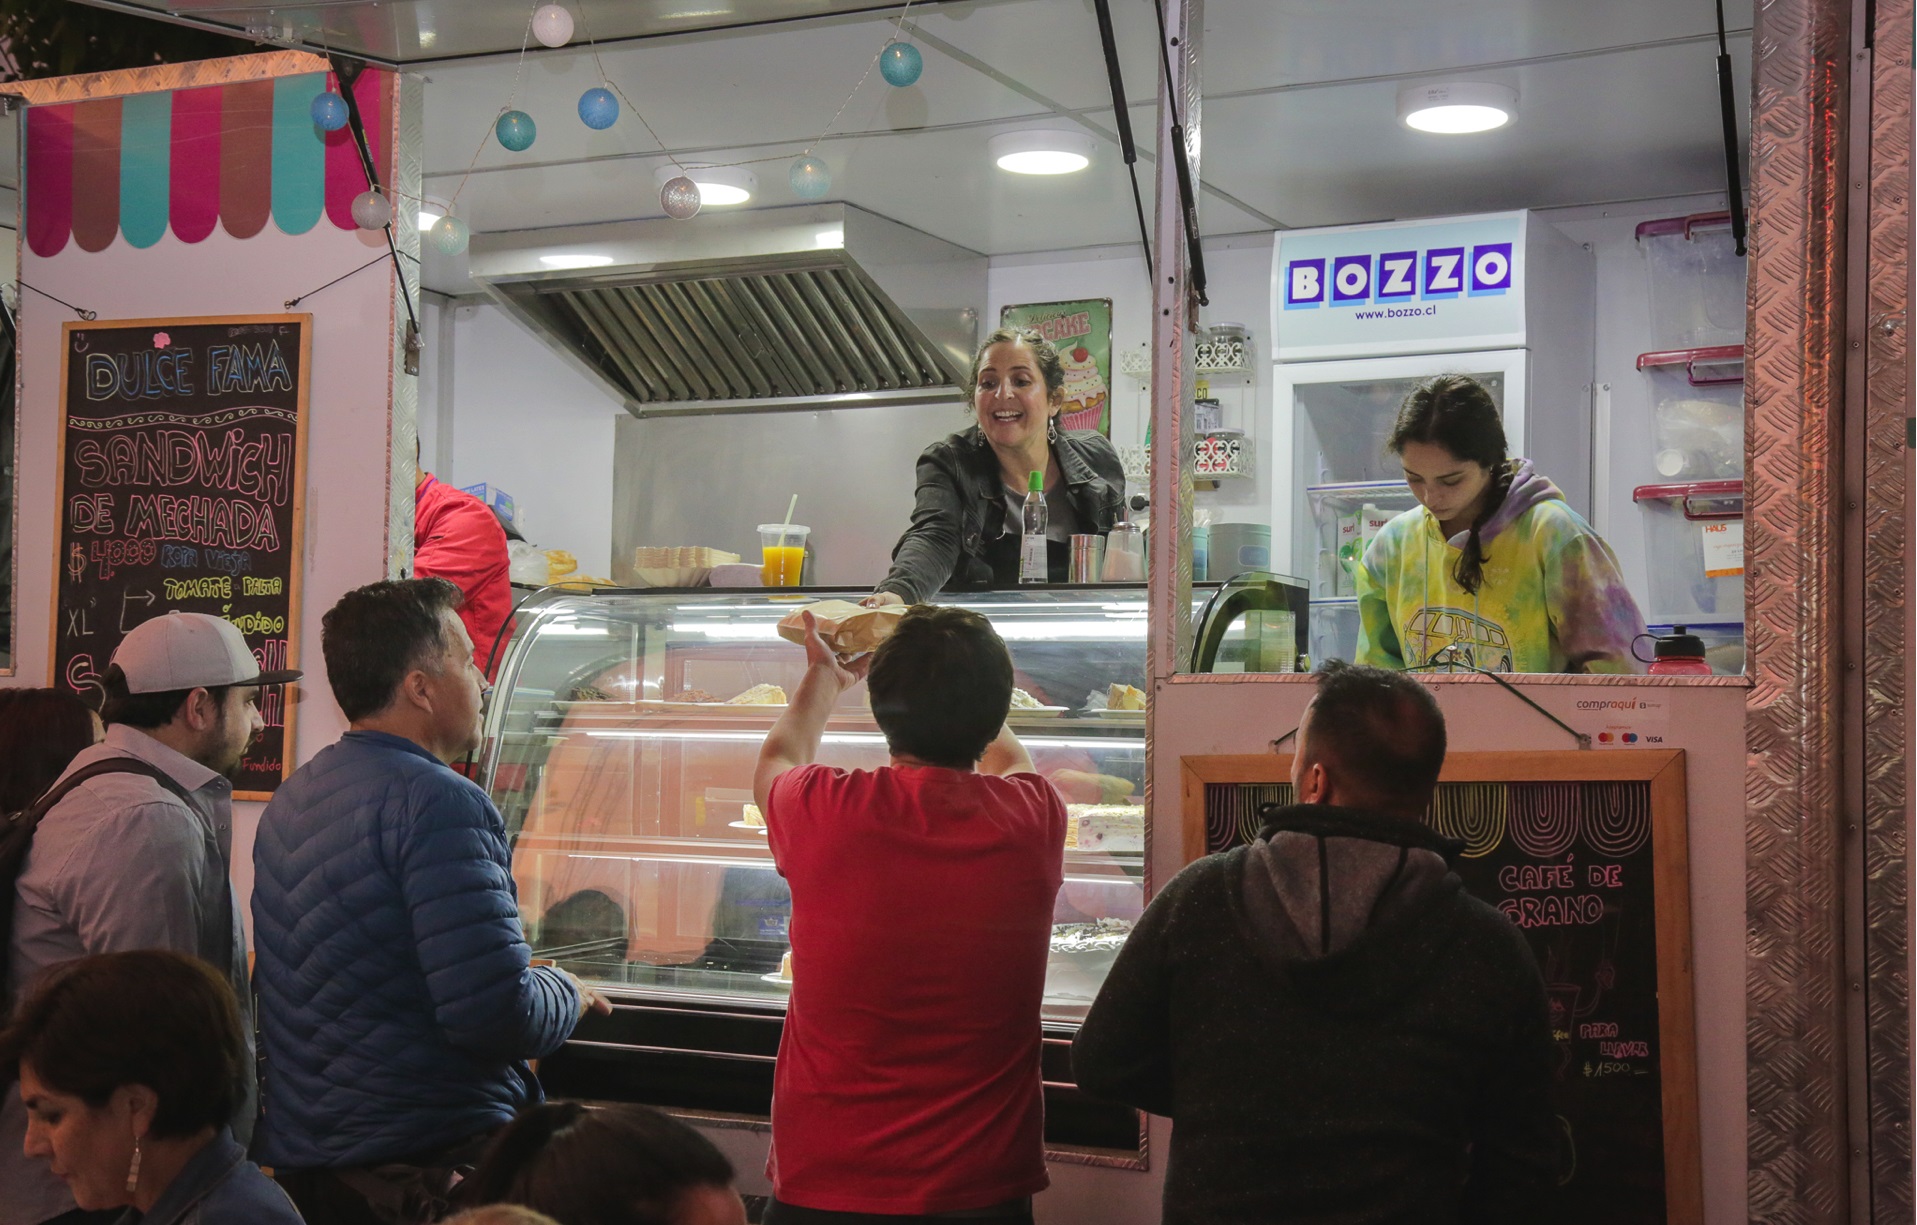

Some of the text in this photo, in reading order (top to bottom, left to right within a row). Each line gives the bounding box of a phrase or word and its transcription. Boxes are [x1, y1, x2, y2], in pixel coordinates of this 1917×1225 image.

[1291, 251, 1508, 300] BOZZO
[1355, 305, 1436, 320] www.bozzo.cl
[86, 339, 293, 400] DULCE FAMA
[70, 493, 279, 551] DE MECHADA
[163, 576, 283, 600] TOMATE PALTA
[67, 608, 94, 637] XL
[1576, 697, 1636, 711] compraquí
[242, 756, 282, 772] Fundido
[1498, 853, 1623, 892] CAFÉ DE
[1497, 894, 1604, 928] GRANO
[1580, 1022, 1618, 1039] PARA
